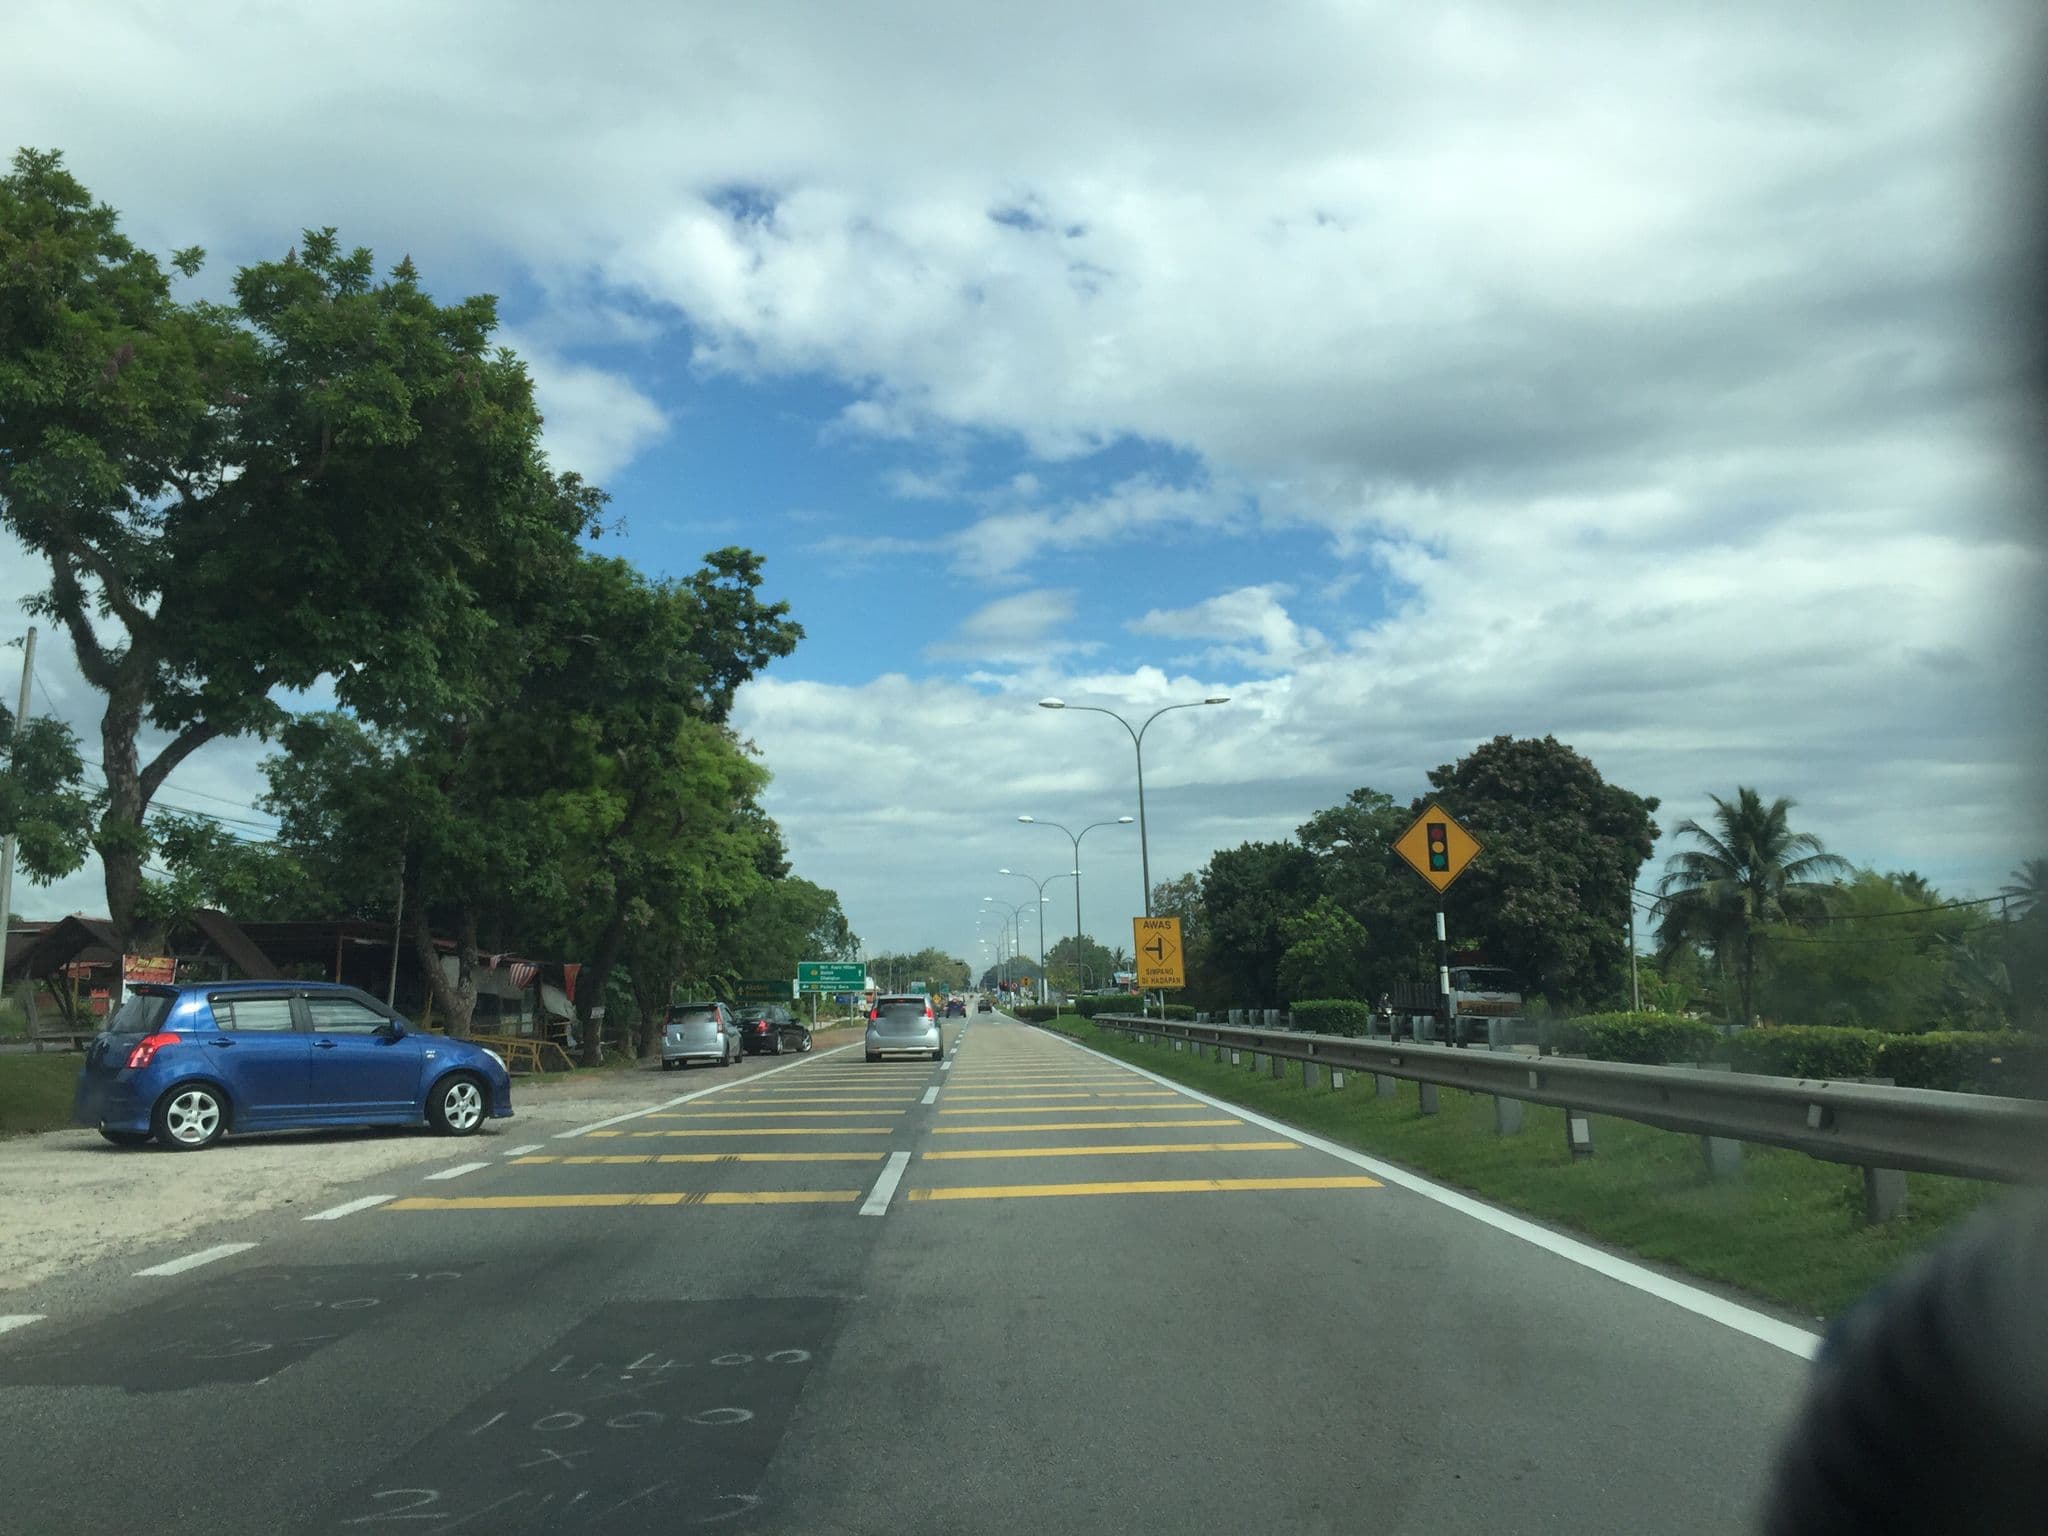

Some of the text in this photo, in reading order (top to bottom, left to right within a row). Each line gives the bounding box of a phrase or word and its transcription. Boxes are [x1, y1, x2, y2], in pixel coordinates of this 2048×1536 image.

[1143, 920, 1171, 929] AWAS
[1145, 967, 1174, 976] SIMPANG
[1151, 976, 1181, 985] HADAPAN
